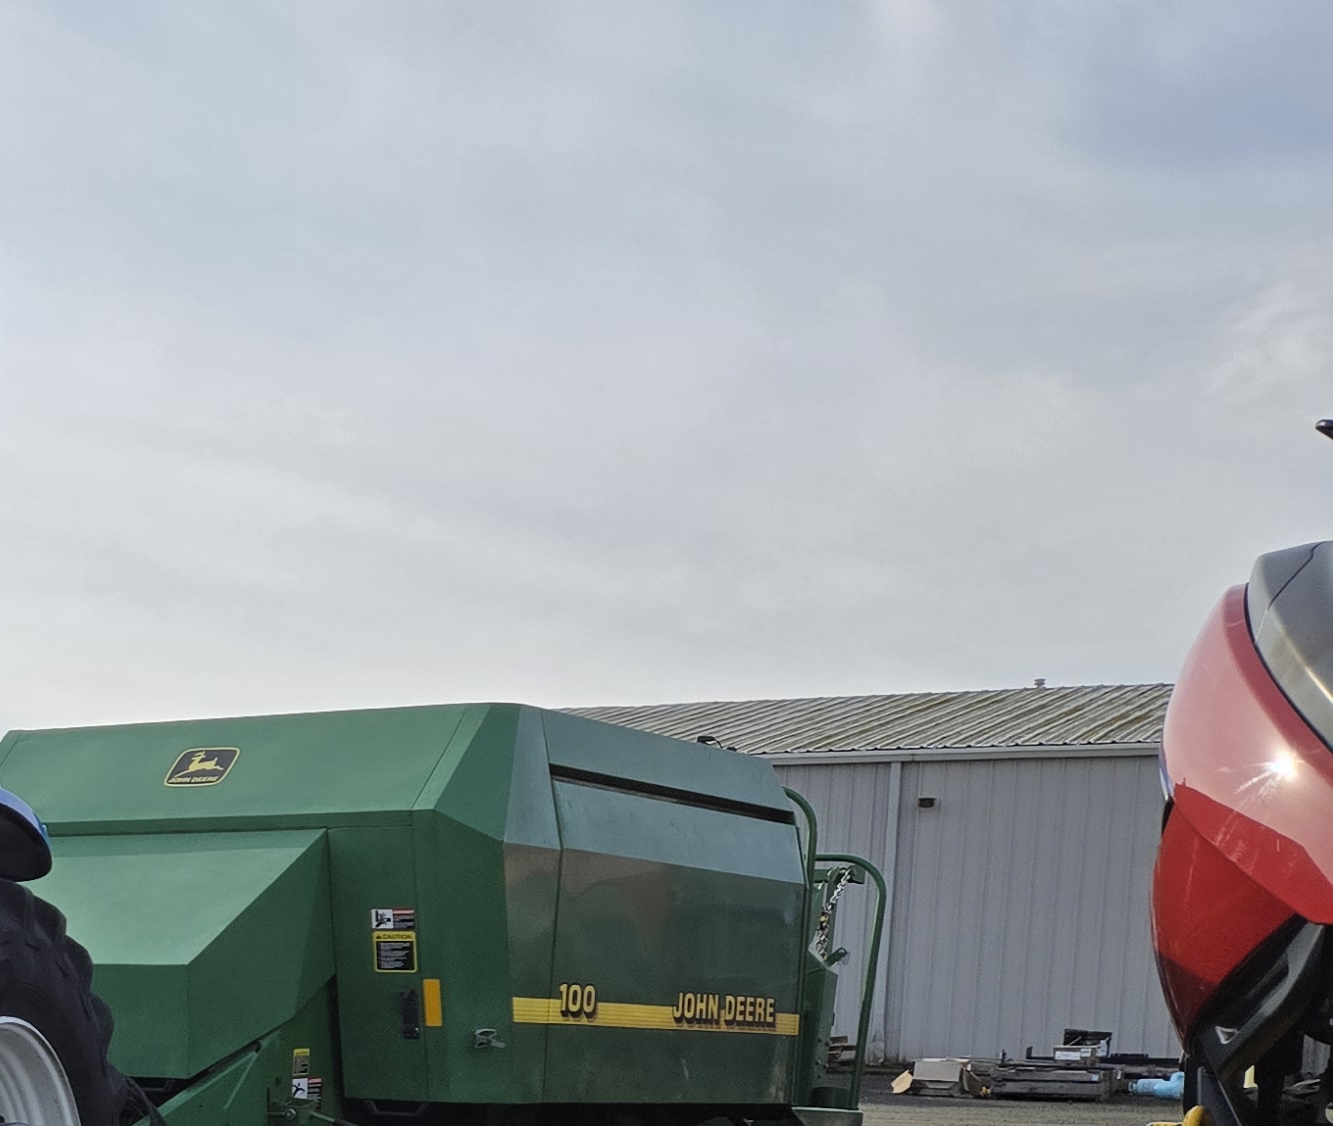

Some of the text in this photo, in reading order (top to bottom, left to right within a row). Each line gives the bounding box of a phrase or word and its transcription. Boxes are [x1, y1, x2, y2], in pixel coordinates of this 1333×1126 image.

[559, 983, 776, 1025] 100 JOHN DEERE
